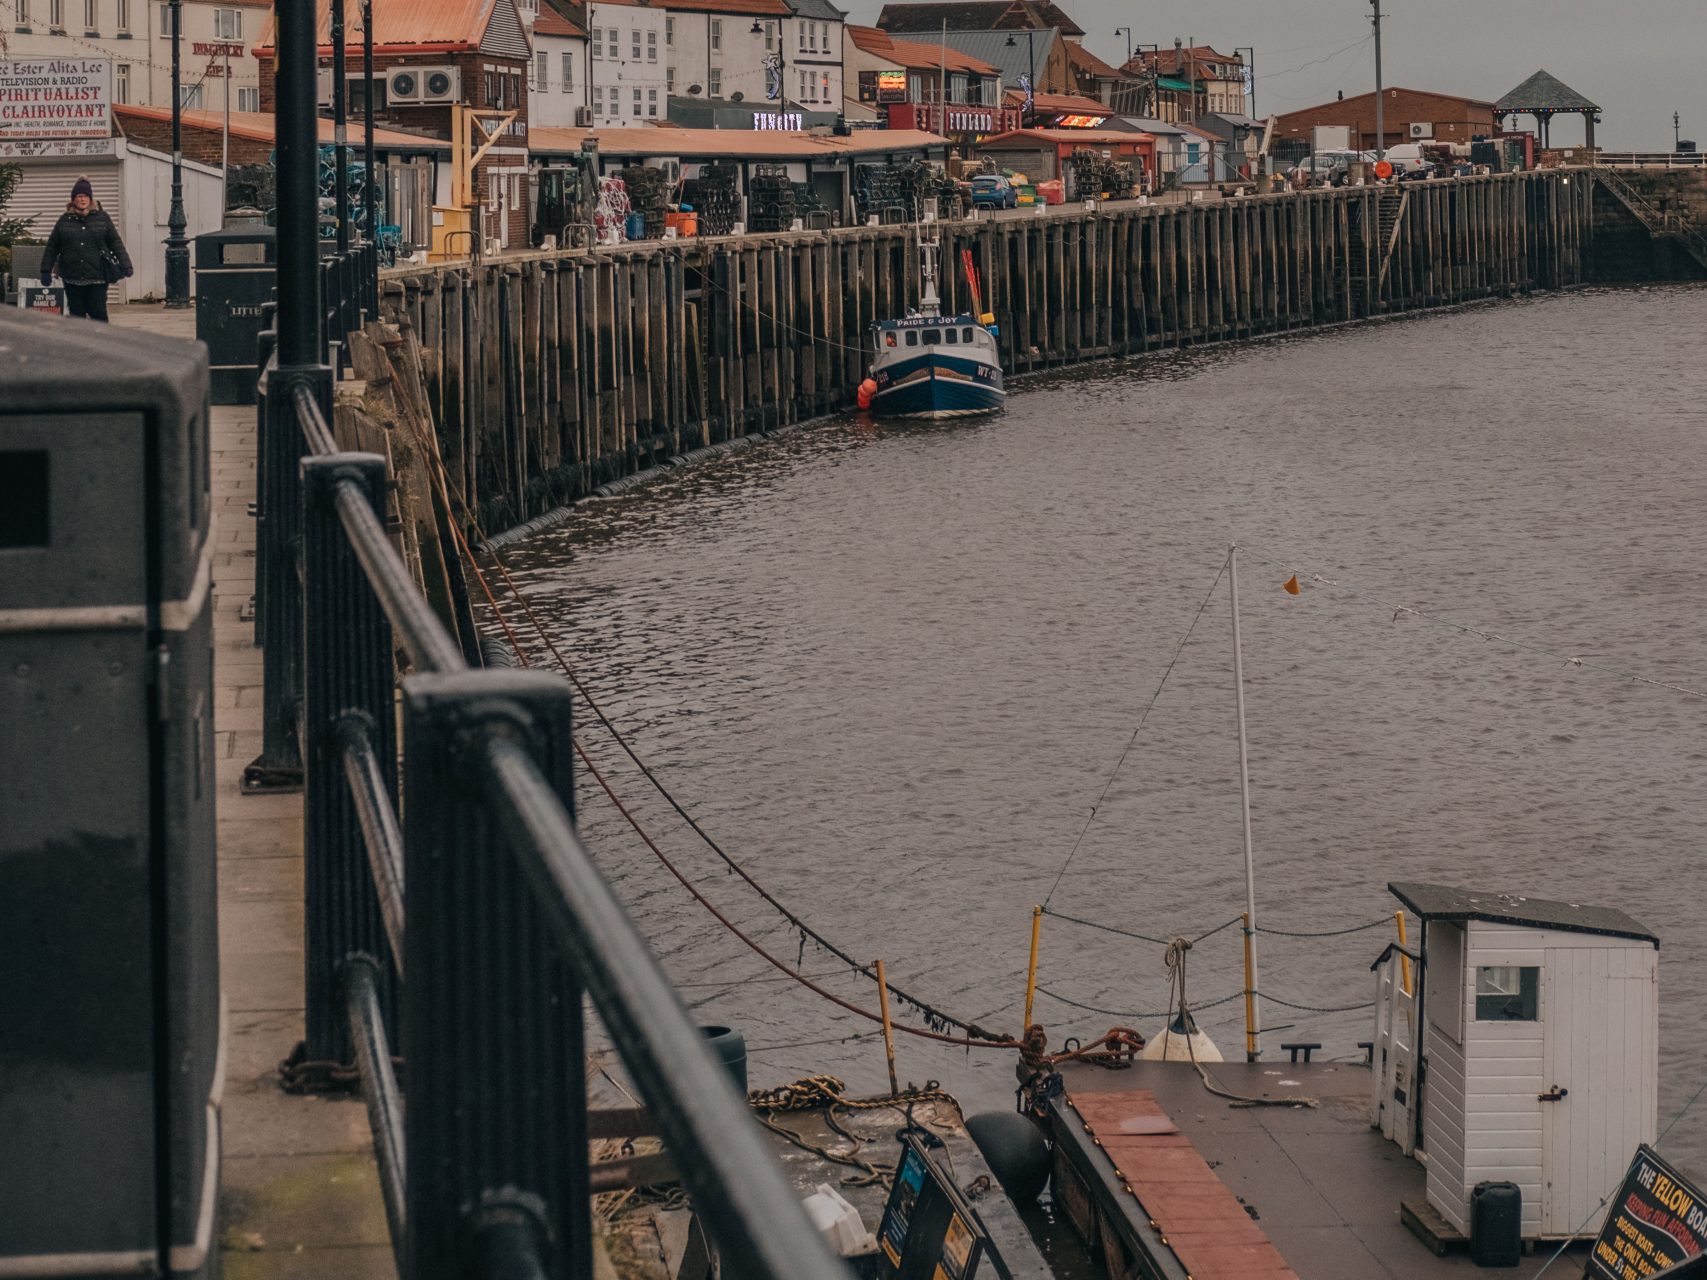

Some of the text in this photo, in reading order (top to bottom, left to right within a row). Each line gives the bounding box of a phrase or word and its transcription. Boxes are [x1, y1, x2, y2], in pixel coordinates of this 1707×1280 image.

[13, 62, 44, 75] Ester
[48, 61, 78, 74] Alita
[82, 61, 102, 73] Lee
[0, 76, 88, 86] TELEVISION & RADIO
[0, 86, 101, 102] PIRITUALIST
[2, 103, 106, 119] CLAIRVOYANT
[753, 112, 776, 131] FUN
[949, 112, 992, 131] FUNLAND
[1637, 1162, 1707, 1239] THE YELLOW BOA
[1616, 1215, 1639, 1241] BIGGEST
[1636, 1233, 1654, 1256] BOATS
[1597, 1240, 1618, 1267] UNDER
[1613, 1235, 1625, 1252] THE
[1624, 1243, 1641, 1266] ONLY
